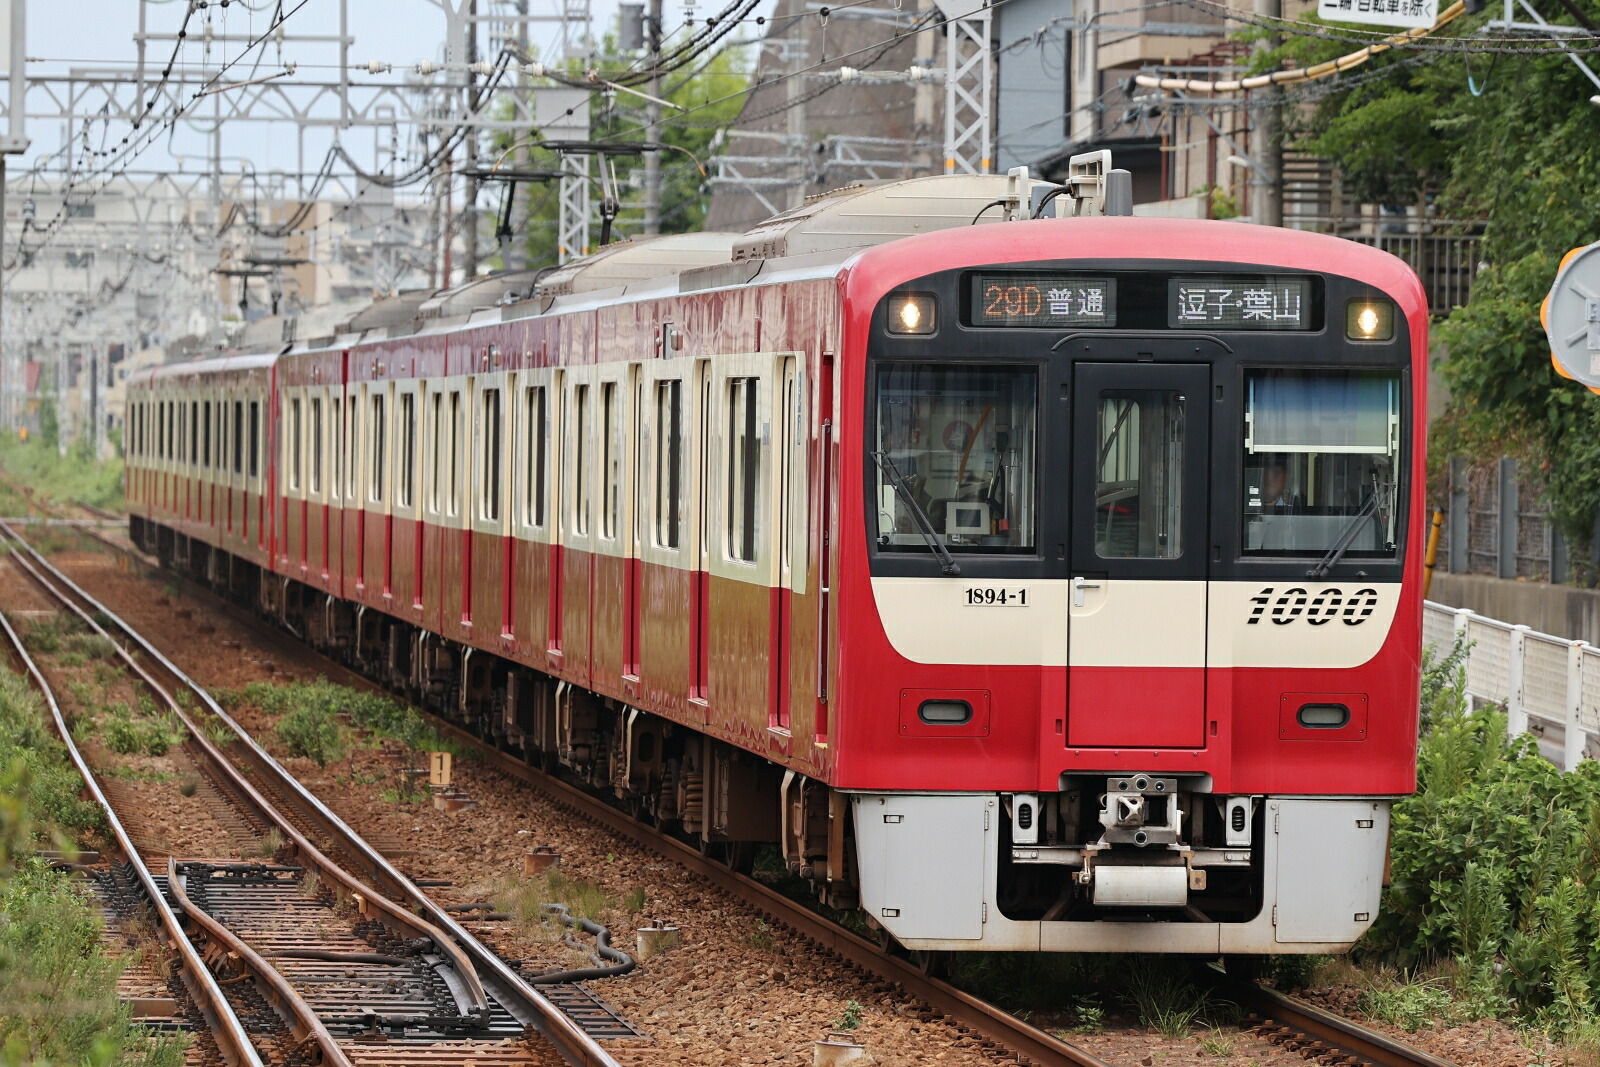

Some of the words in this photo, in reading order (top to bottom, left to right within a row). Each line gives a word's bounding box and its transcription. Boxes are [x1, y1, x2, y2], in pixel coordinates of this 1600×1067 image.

[985, 285, 1042, 316] 29D
[1047, 288, 1104, 316] 普通
[1178, 287, 1301, 321] 逗子・葉山
[965, 588, 1027, 605] 1894-1
[1247, 587, 1378, 626] 1000
